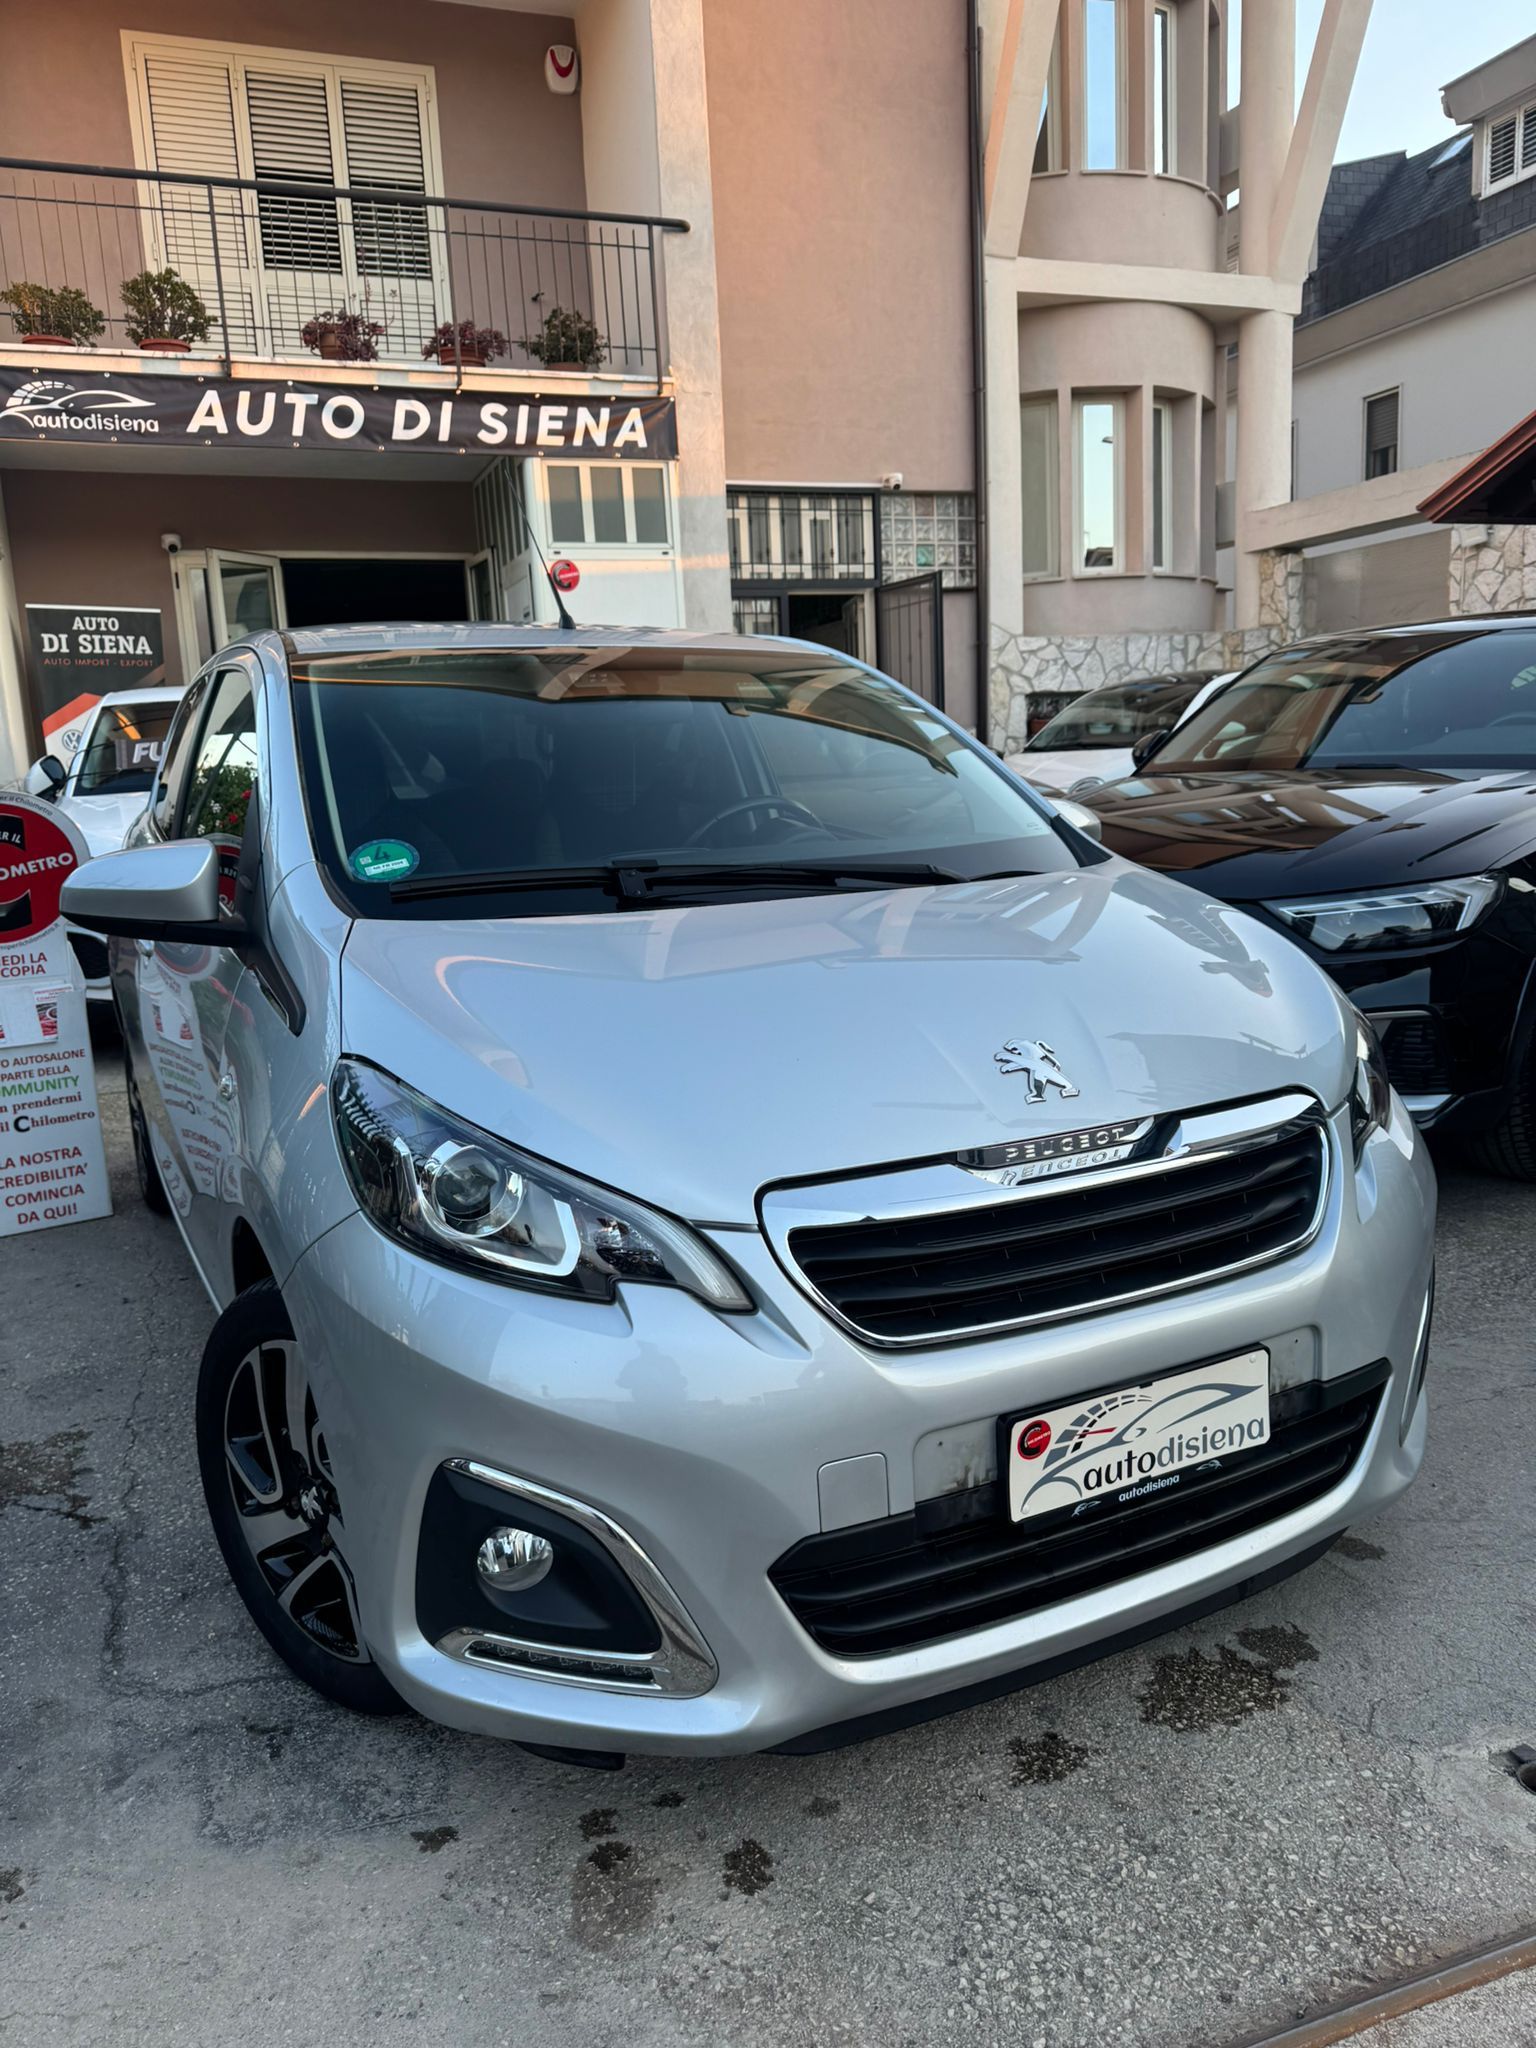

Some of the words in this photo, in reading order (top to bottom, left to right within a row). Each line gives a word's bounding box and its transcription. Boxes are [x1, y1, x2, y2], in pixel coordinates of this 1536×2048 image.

[34, 411, 160, 434] autodisiena
[186, 389, 365, 440] AUTO
[391, 398, 453, 442] DI
[477, 402, 648, 448] SIENA
[72, 616, 119, 631] AUTO
[41, 633, 70, 653] DI
[78, 634, 153, 655] SIENA
[44, 658, 71, 666] AUTO
[75, 658, 110, 667] IMPORT
[120, 659, 153, 668] EXPORT
[11, 833, 21, 843] IL
[0, 852, 74, 880] OMETRO
[30, 952, 47, 963] LA
[0, 964, 46, 978] COPIA
[1, 1059, 10, 1068] O
[13, 1048, 86, 1066] AUTOSALONE
[1, 1069, 35, 1082] PARTE
[37, 1064, 70, 1077] DELLA
[0, 1075, 80, 1097] MMUNITY
[12, 1092, 82, 1115] prendermi
[0, 1121, 10, 1132] il
[13, 1110, 95, 1133] Chilometro
[1004, 1126, 1125, 1162] PEUGEOT
[20, 1146, 82, 1167] NOSTRA
[5, 1184, 85, 1208] COMINCIA
[17, 1211, 39, 1225] DA
[43, 1202, 78, 1220] QUI!
[1083, 1416, 1265, 1492] autodisiena
[1118, 1474, 1180, 1502] autodisiena
